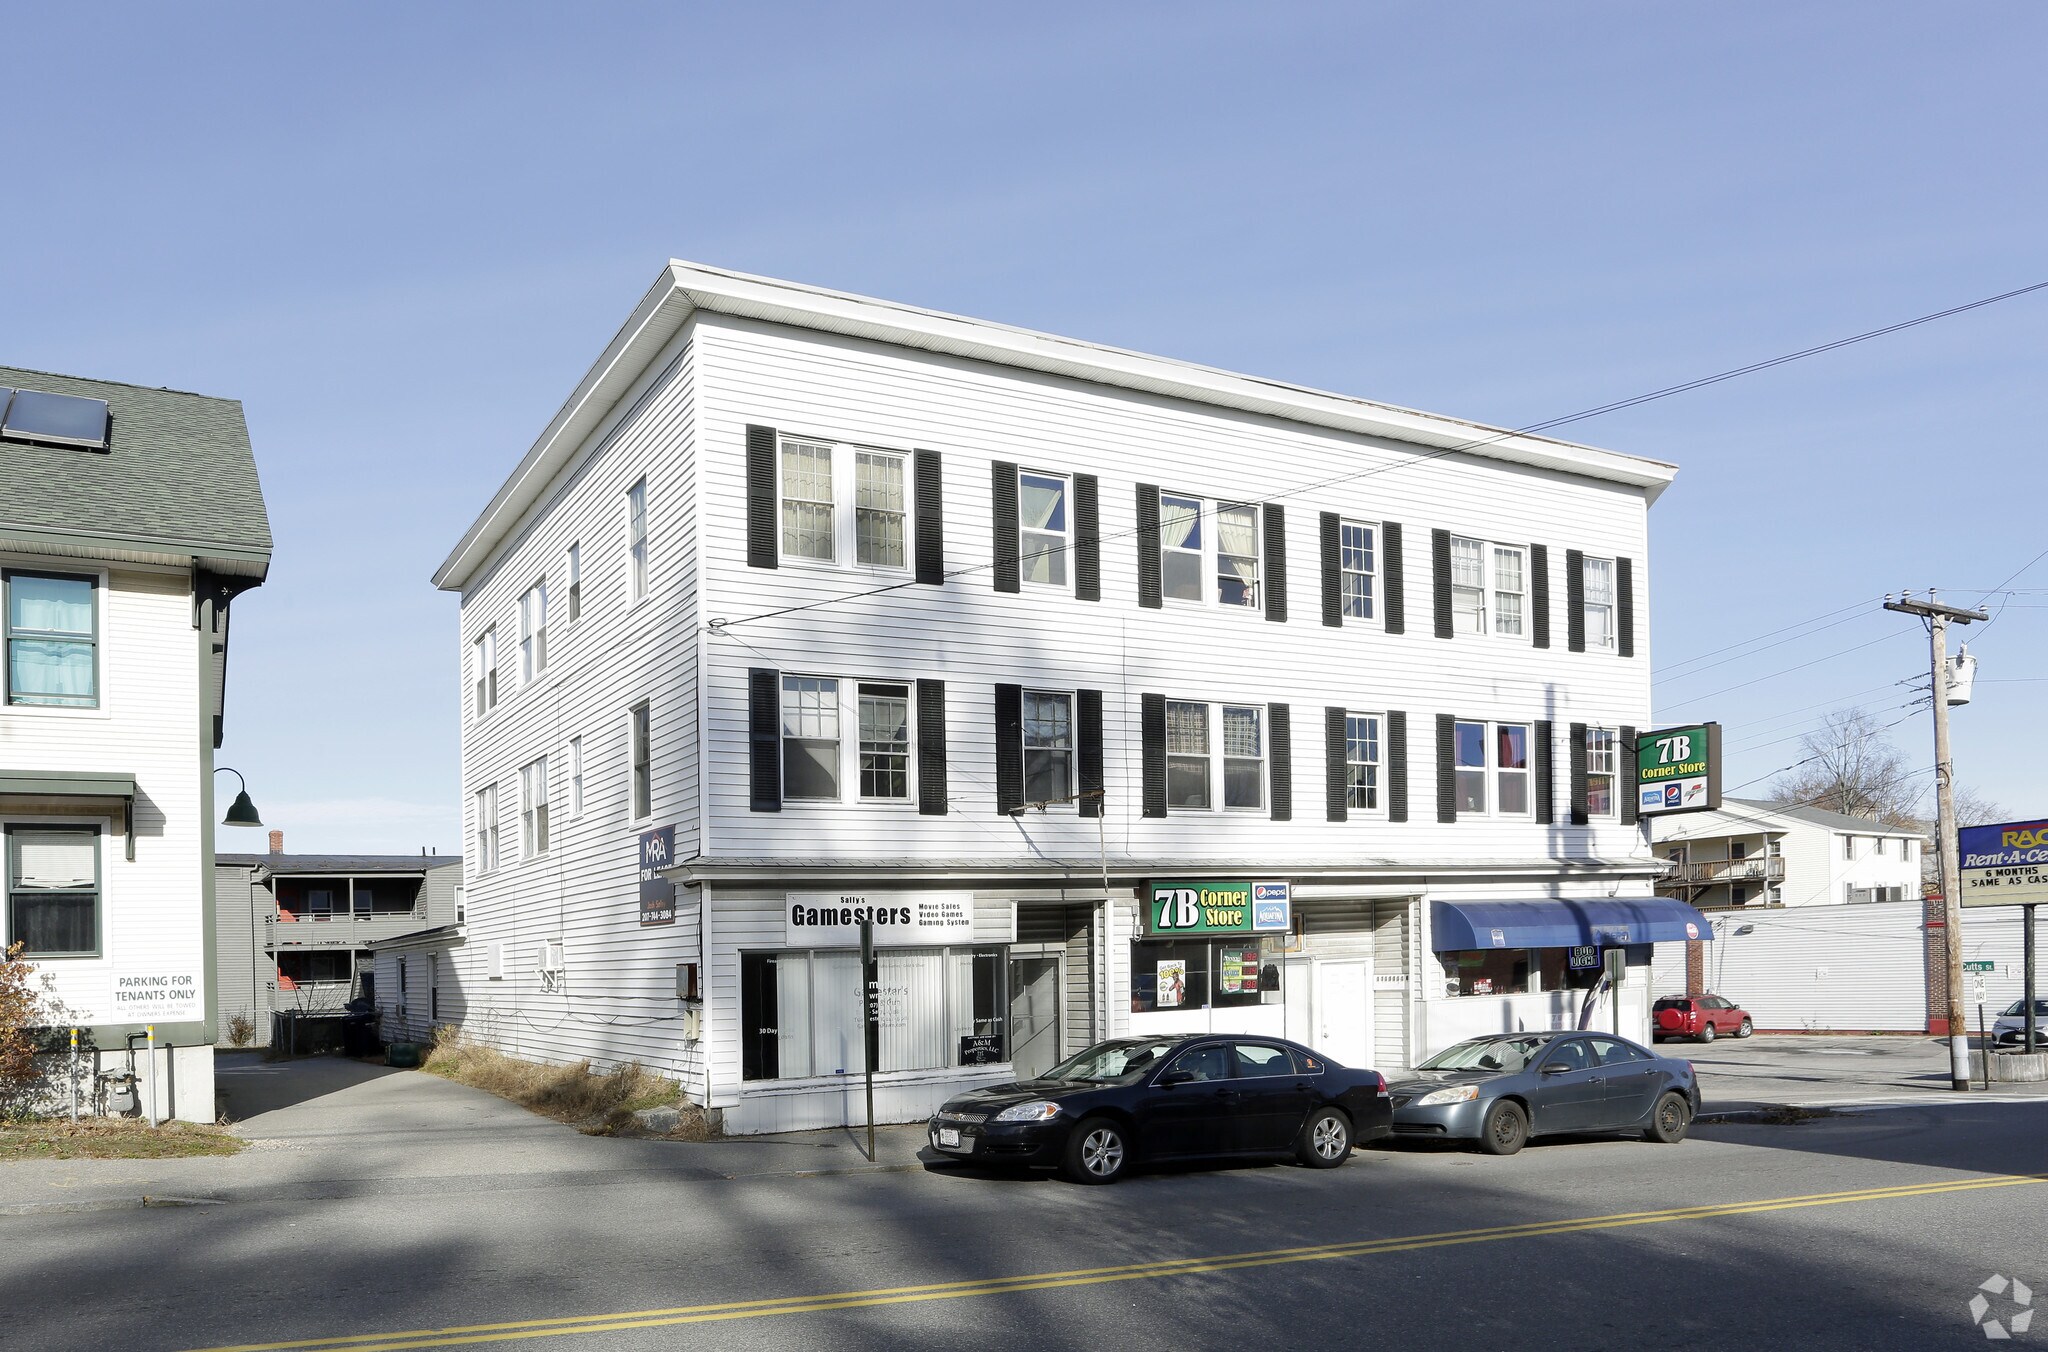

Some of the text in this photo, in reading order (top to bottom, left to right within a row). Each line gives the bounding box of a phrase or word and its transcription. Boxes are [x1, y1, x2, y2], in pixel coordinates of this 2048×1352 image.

[1655, 735, 1691, 764] 7B
[1641, 761, 1706, 779] Corner Store
[640, 868, 652, 882] FOR
[1985, 866, 2038, 877] 6 MONTHS
[1971, 875, 2048, 888] SAME AS CAS
[1266, 888, 1286, 897] pepsi
[840, 896, 866, 904] Sally's
[1153, 888, 1248, 928] 7B Corner
[791, 904, 911, 926] Gamesters
[1205, 907, 1243, 927] Store
[918, 919, 944, 927] Gaming
[1574, 946, 1595, 956] BUD
[1570, 955, 1598, 967] LIGHT
[1962, 962, 1983, 971] Cutts
[119, 975, 193, 987] PARKING FOR
[1974, 979, 1985, 989] ONE
[115, 989, 196, 1001] TENANTS ONLY
[1975, 991, 1985, 1001] WAY
